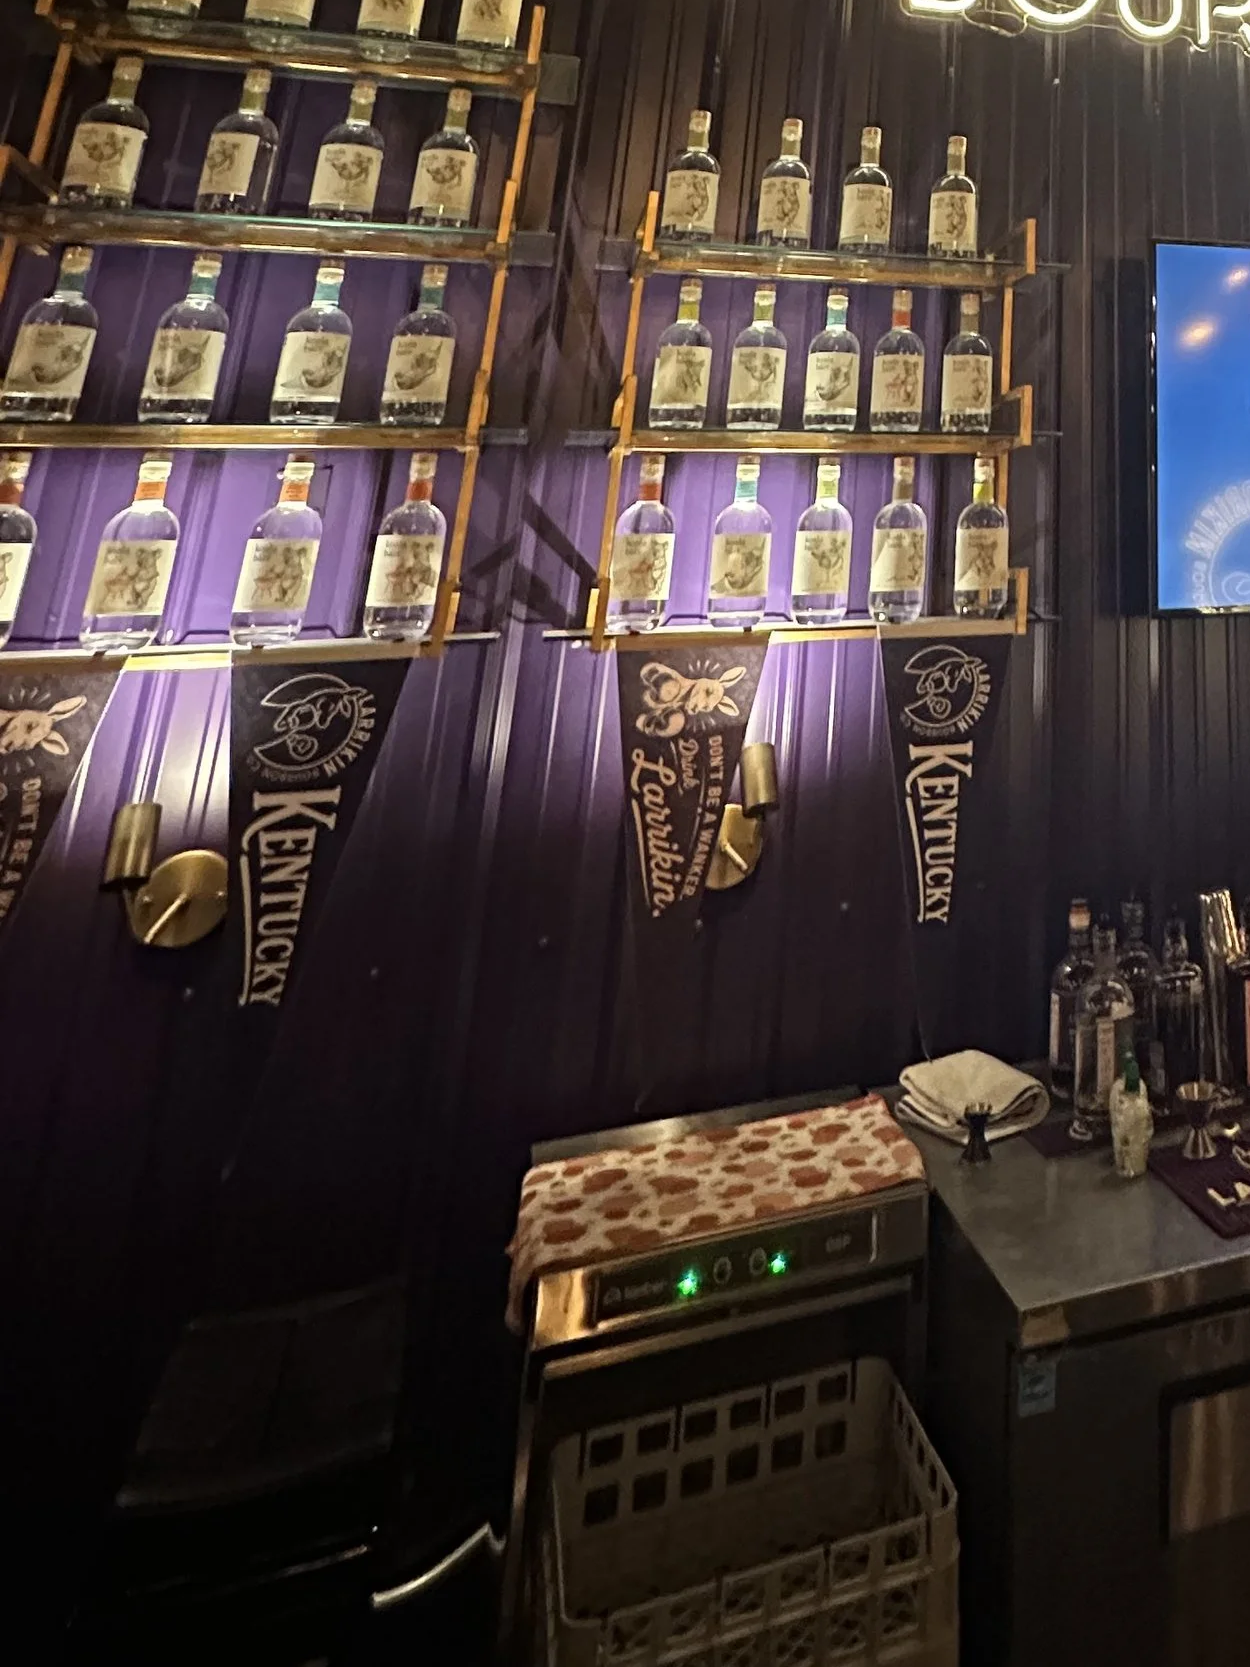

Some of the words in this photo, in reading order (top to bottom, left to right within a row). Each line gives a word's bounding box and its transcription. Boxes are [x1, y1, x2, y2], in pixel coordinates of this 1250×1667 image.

[956, 662, 992, 734] LARRIKIN
[323, 693, 377, 778] LARRIKIN
[708, 734, 725, 781] DON'T
[678, 737, 701, 791] Drink
[702, 811, 718, 824] A
[705, 785, 723, 808] BE
[9, 837, 34, 865] BE
[905, 739, 974, 926] KENTUCKY
[1, 869, 23, 884] A
[679, 827, 714, 902] WANKER
[241, 785, 342, 1007] KENTUCKY
